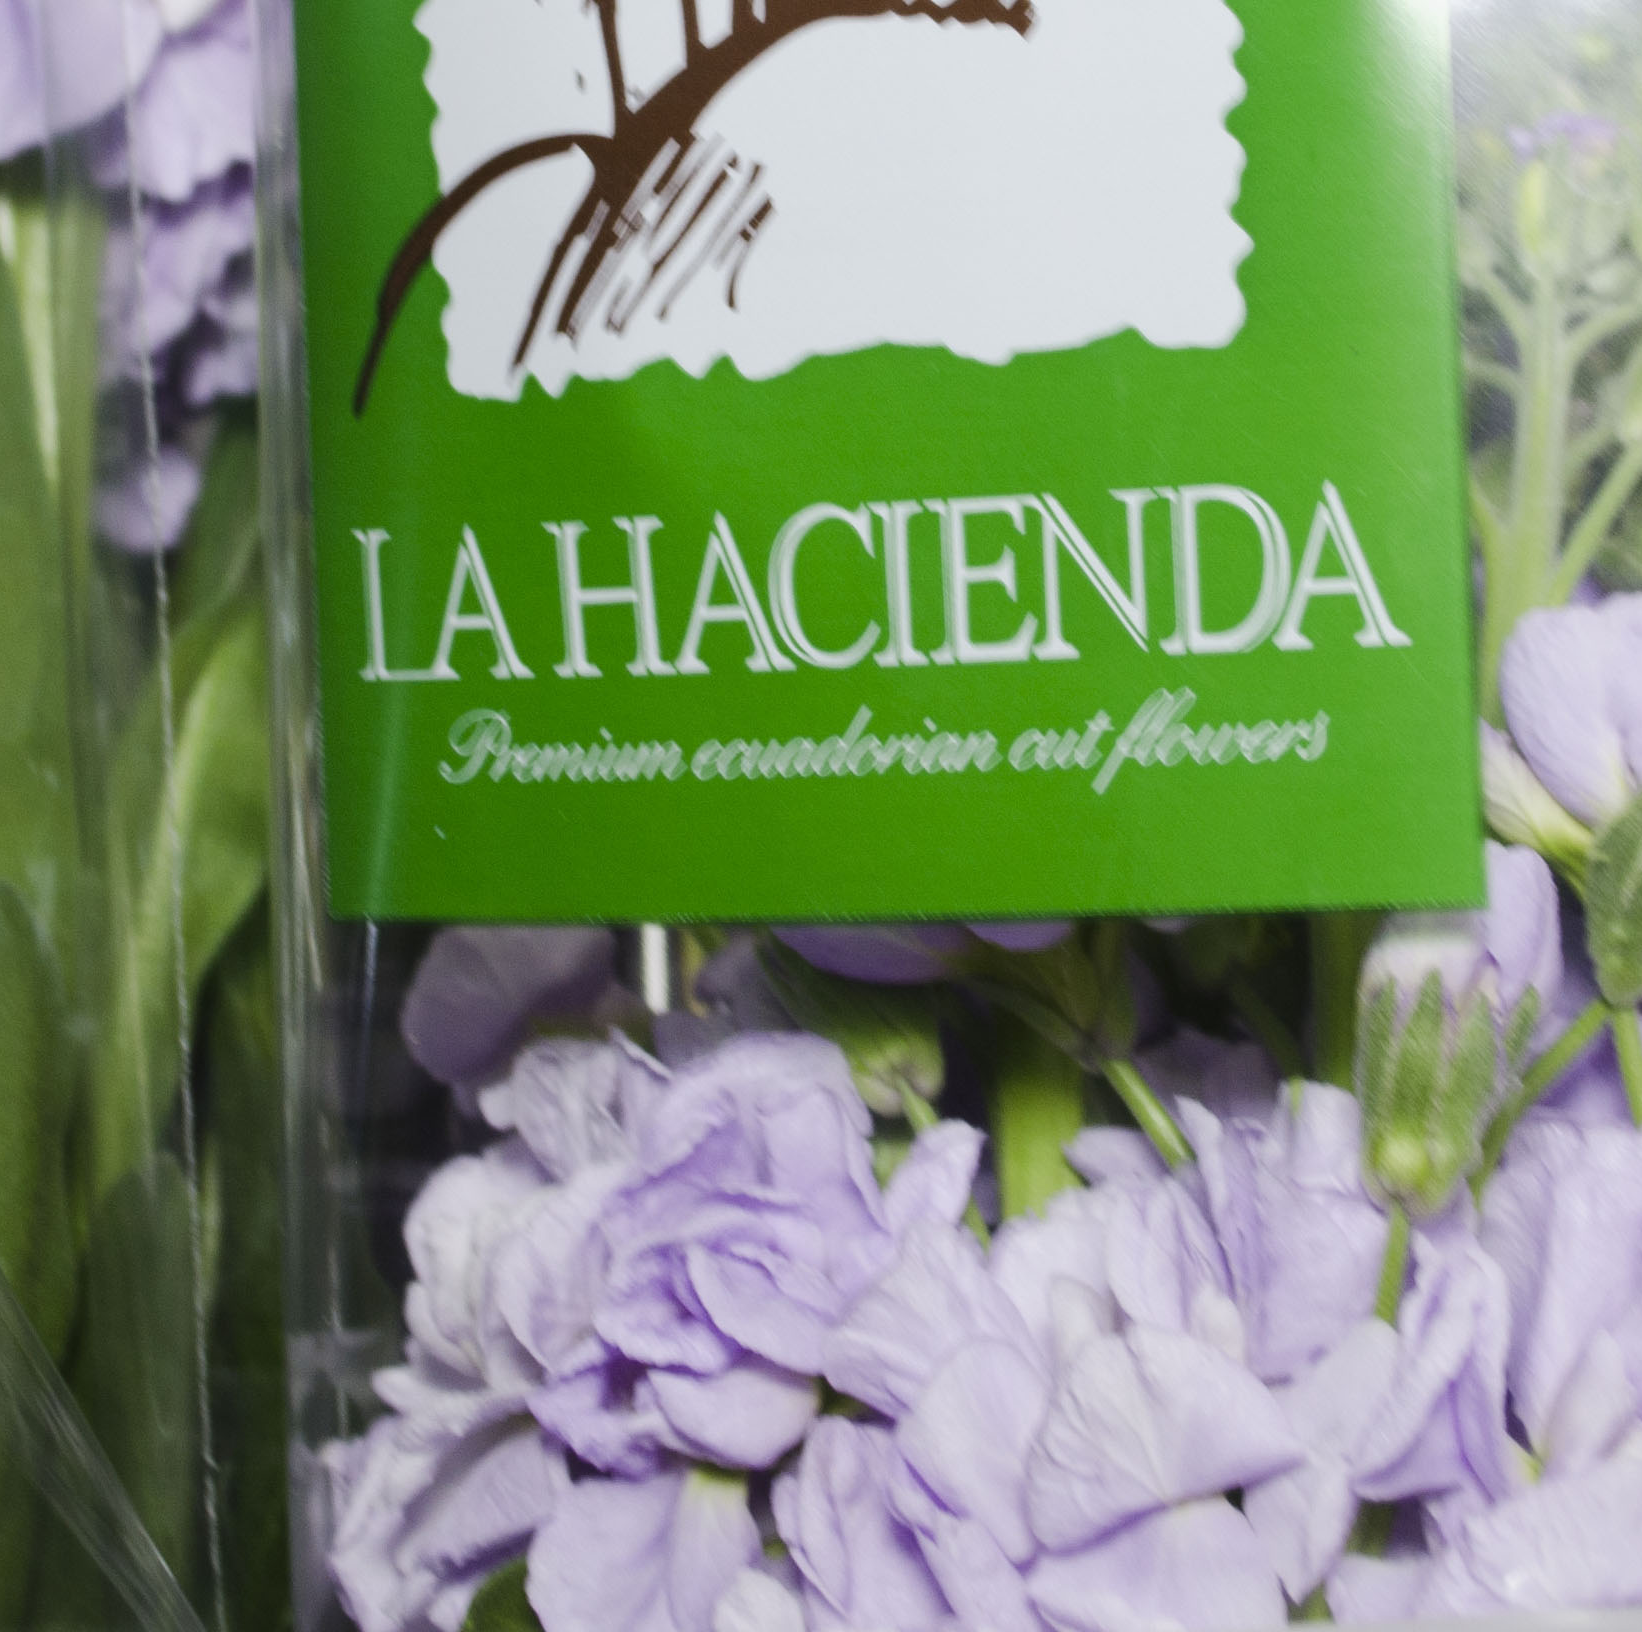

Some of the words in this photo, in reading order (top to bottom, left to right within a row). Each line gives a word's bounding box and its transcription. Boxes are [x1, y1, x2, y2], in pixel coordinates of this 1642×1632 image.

[352, 522, 535, 680] LA
[541, 479, 1413, 677] HACIENDA
[438, 707, 689, 784] Premium
[691, 704, 1003, 781] ecuadorian
[1008, 710, 1114, 771] cut
[1090, 686, 1330, 796] flowers
